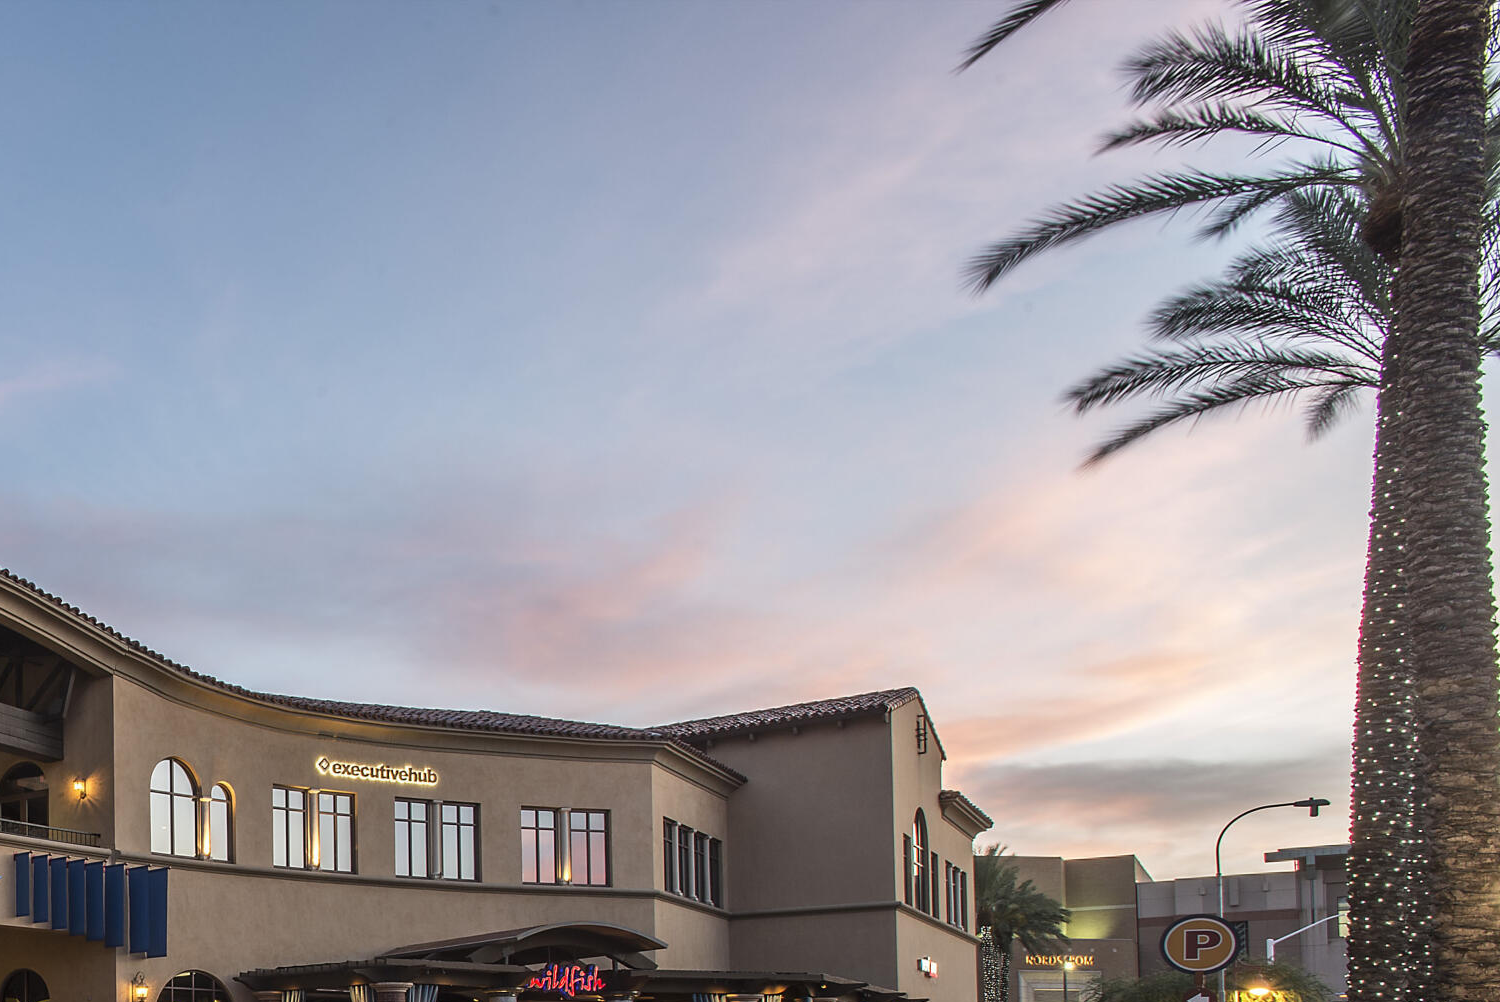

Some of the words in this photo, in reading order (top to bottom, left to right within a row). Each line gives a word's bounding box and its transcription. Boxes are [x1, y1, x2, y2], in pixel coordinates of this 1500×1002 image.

[331, 761, 439, 785] executivehub
[1183, 929, 1223, 961] P
[529, 963, 607, 997] wildfish
